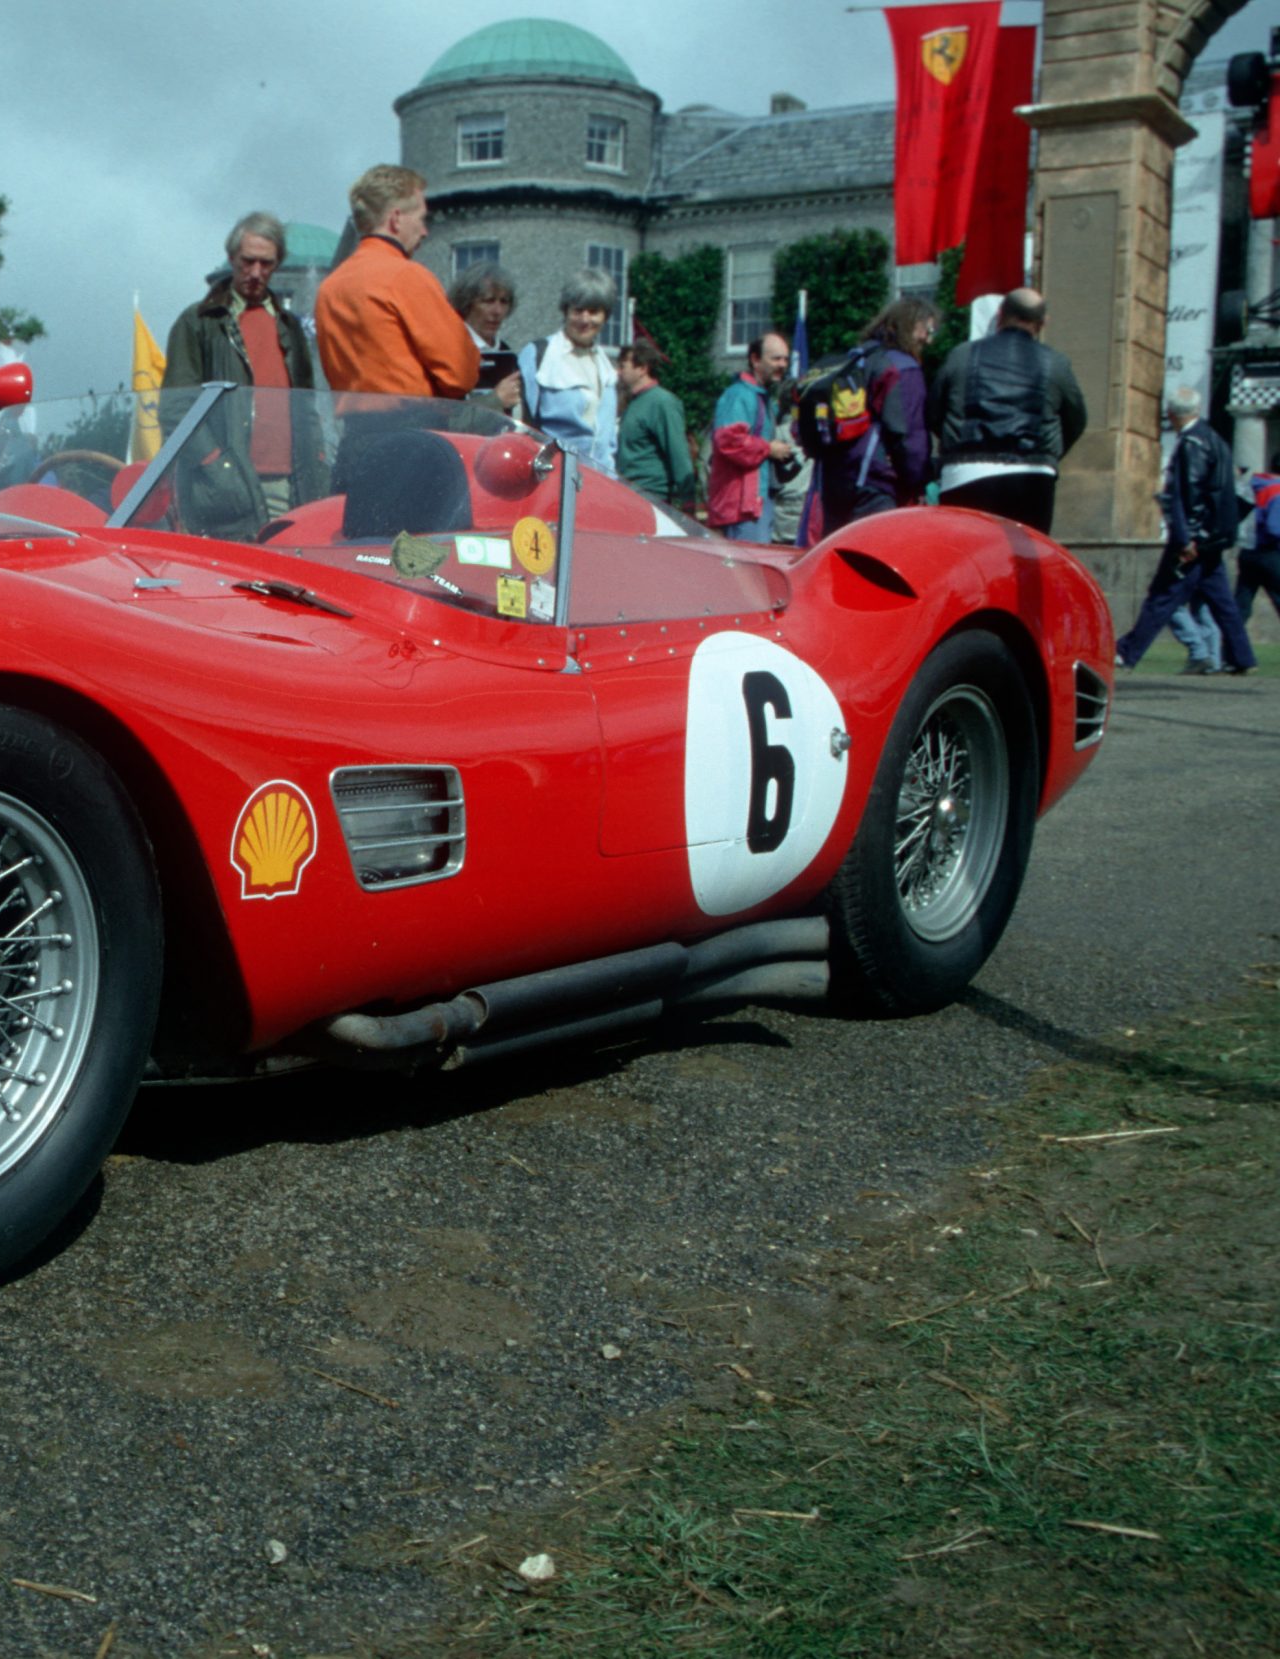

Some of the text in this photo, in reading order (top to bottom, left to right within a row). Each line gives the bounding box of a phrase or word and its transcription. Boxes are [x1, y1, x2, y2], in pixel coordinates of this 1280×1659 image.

[529, 531, 543, 560] 4
[356, 555, 390, 566] RACING
[742, 671, 795, 853] 6
